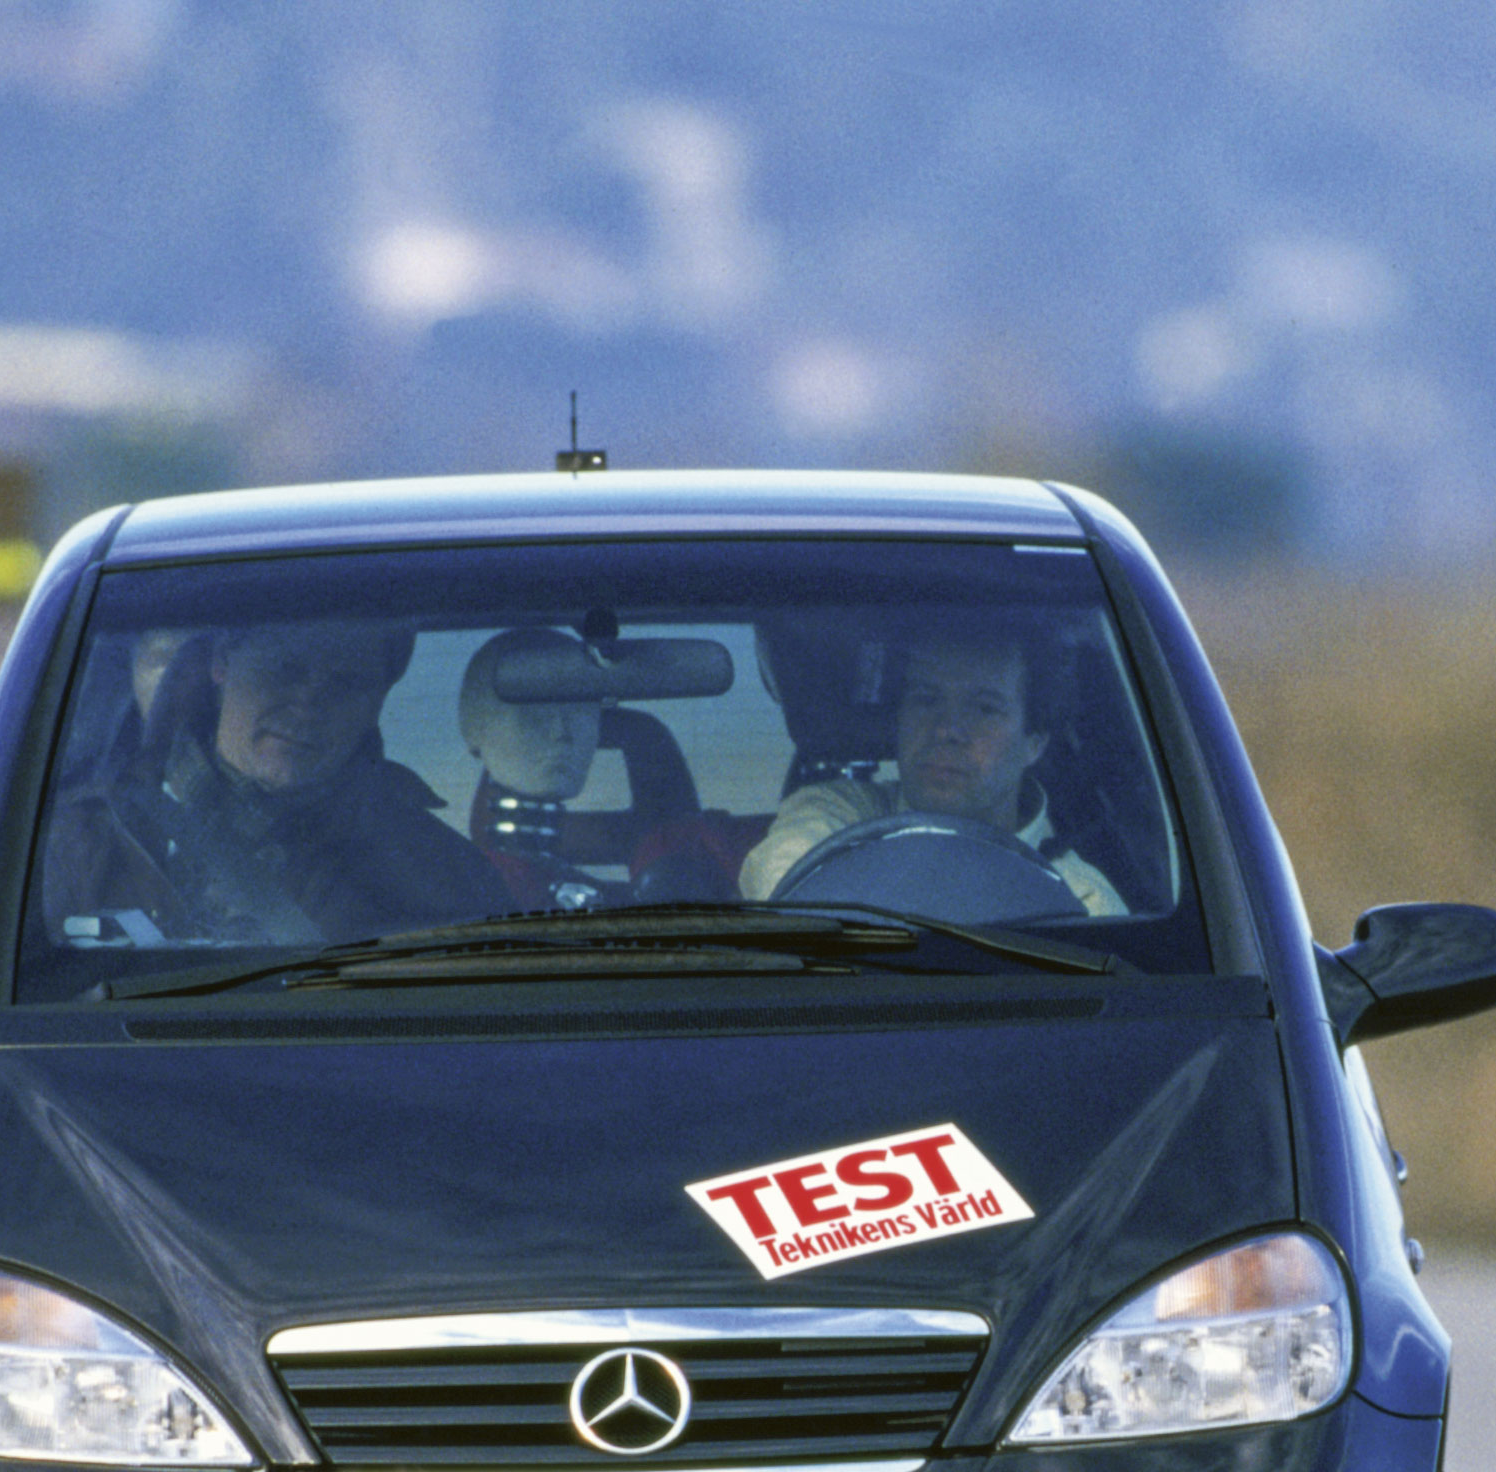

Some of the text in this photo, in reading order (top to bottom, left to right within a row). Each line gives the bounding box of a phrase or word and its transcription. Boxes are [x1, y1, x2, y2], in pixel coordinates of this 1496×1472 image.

[705, 1133, 961, 1239] TEST
[758, 1189, 1004, 1267] Teknikens Värld
